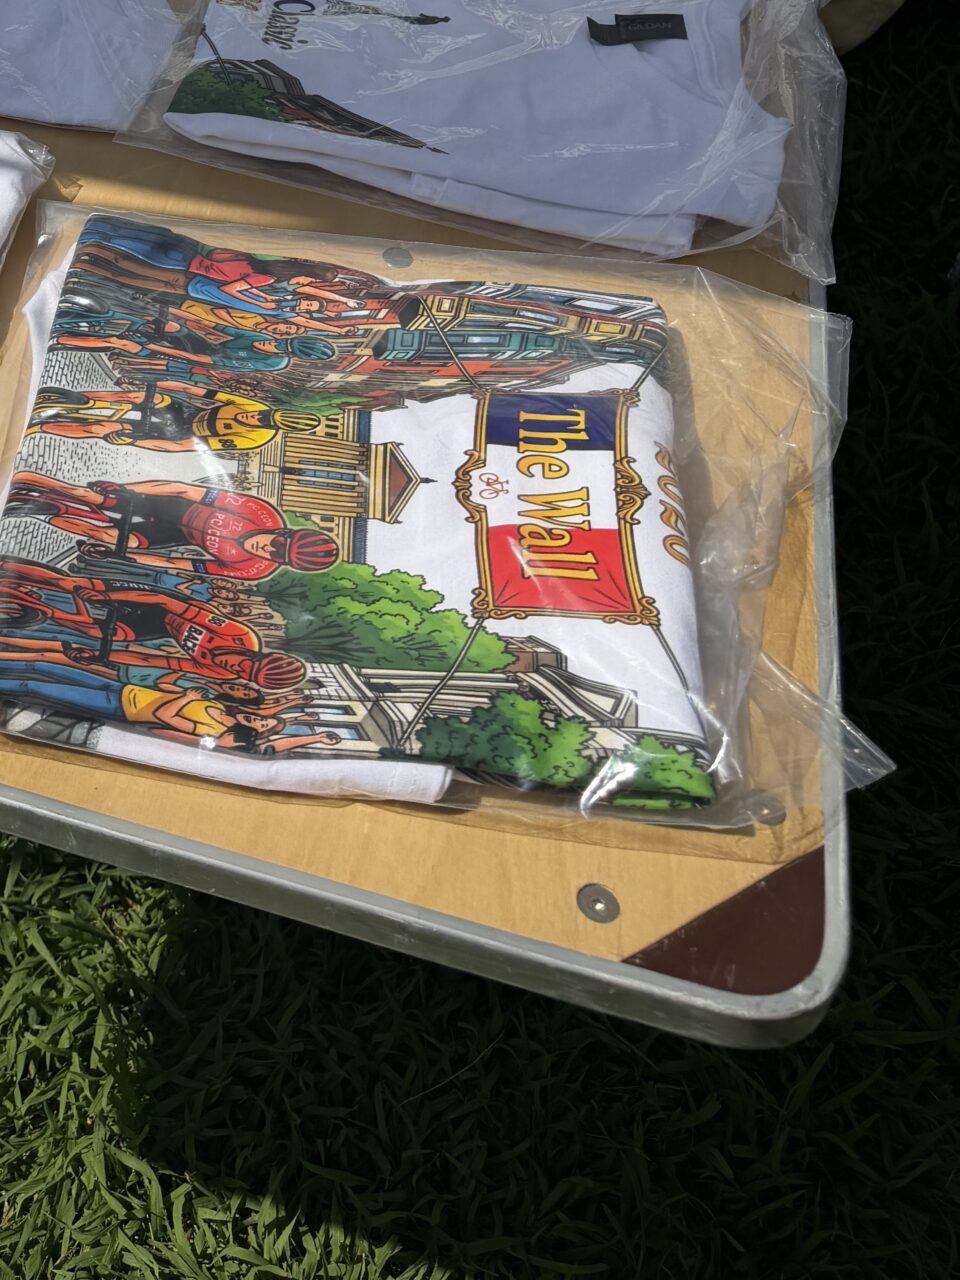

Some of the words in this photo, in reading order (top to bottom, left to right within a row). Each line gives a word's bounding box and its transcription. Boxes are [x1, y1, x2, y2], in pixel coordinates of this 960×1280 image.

[261, 0, 316, 50] Classic
[517, 408, 589, 479] The
[517, 487, 600, 580] Wall
